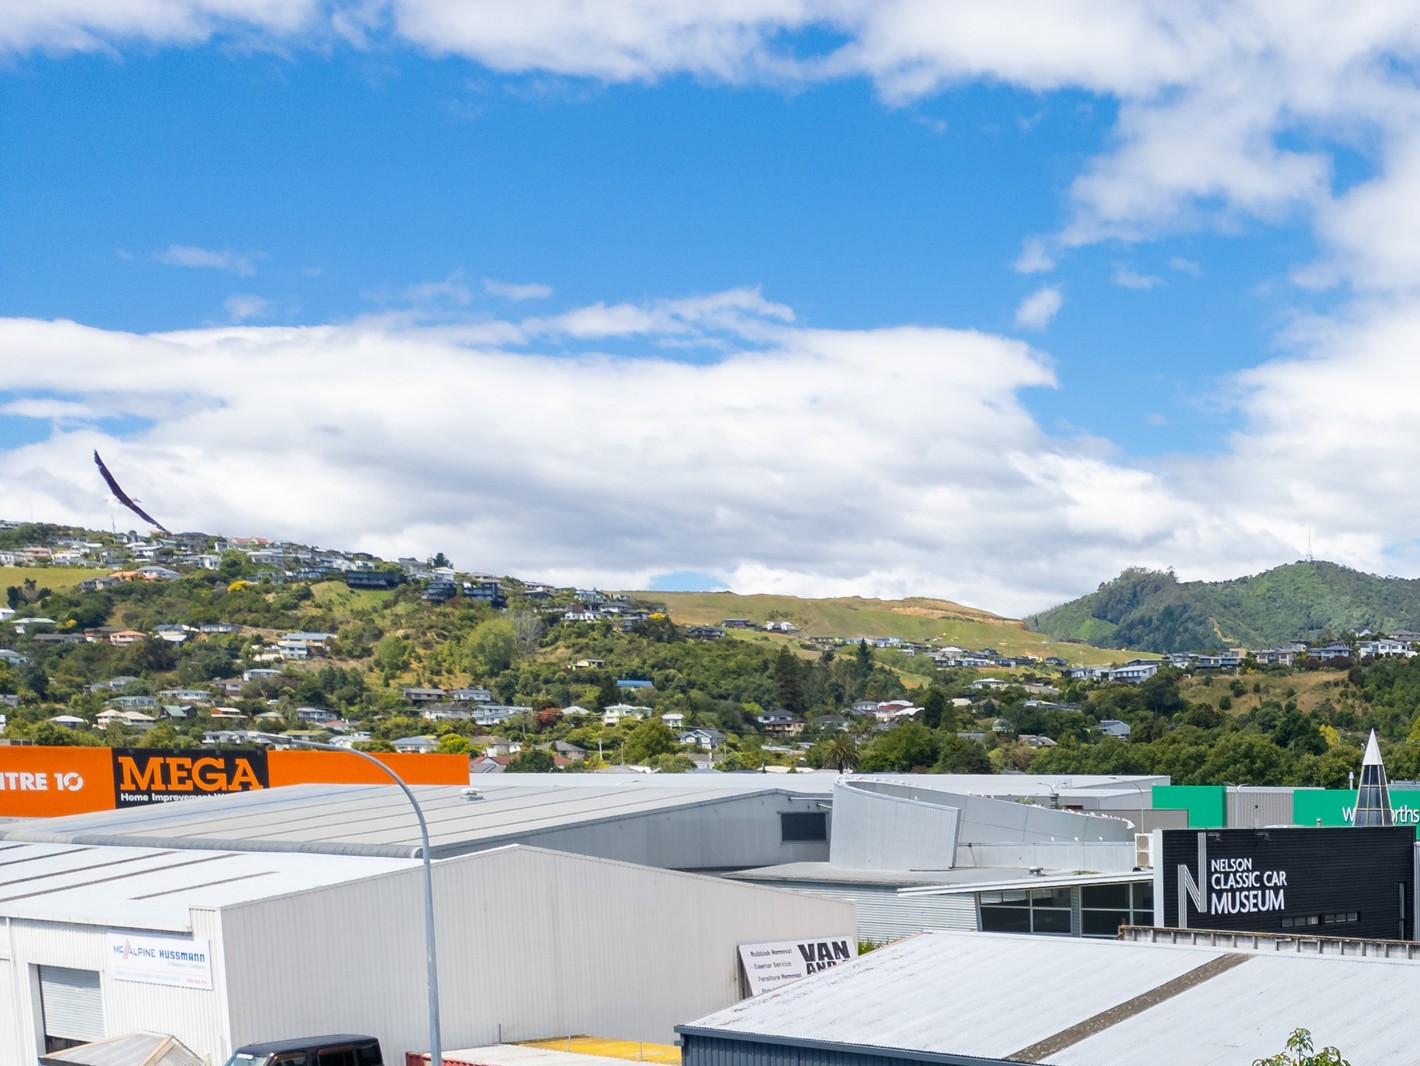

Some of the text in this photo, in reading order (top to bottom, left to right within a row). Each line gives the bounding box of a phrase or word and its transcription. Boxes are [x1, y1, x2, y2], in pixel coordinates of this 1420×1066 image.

[118, 757, 263, 791] MEGA
[121, 793, 149, 802] Home
[1211, 858, 1252, 872] NELSON
[1211, 871, 1287, 889] CLASSIC CAR
[1211, 889, 1285, 915] MUSEUM
[797, 940, 851, 962] VAN
